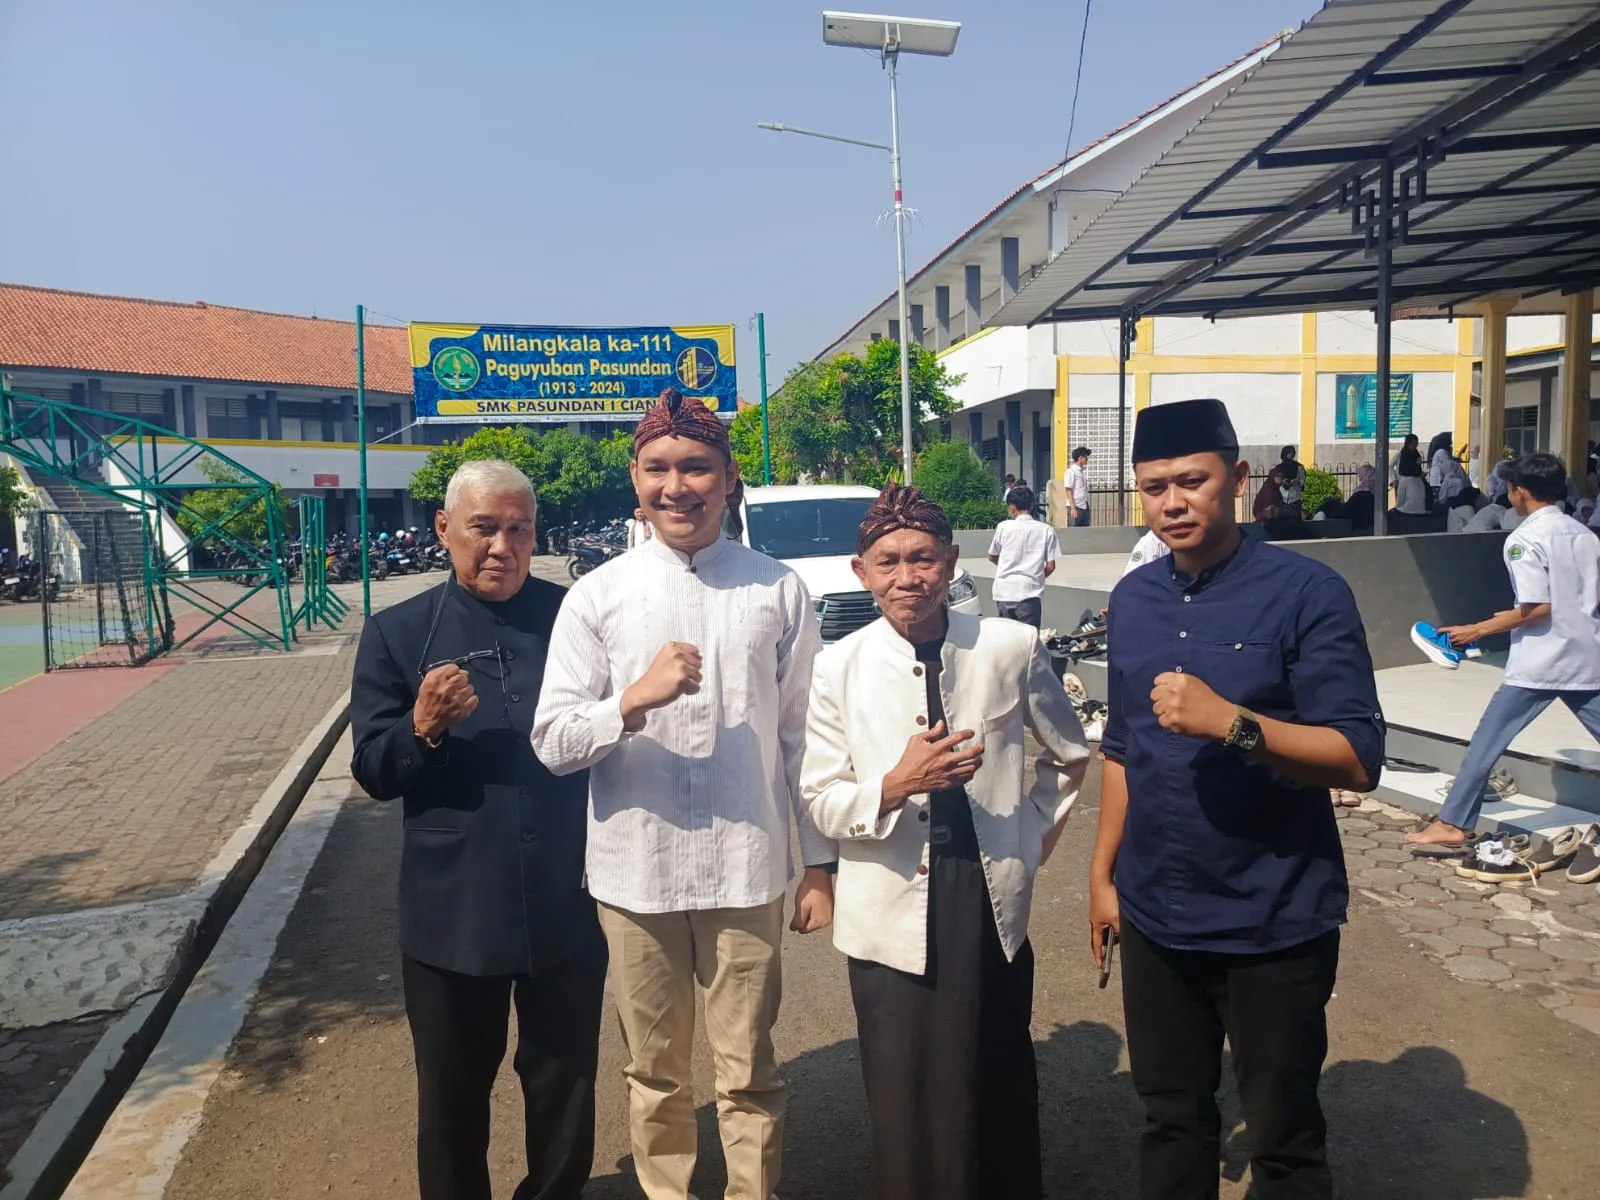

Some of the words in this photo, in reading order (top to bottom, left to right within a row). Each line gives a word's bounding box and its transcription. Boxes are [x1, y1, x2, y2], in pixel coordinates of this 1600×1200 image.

[483, 334, 601, 356] Milangkala
[607, 334, 671, 352] ka-111
[486, 358, 584, 380] Paguyuban
[589, 358, 671, 376] Pasundan
[539, 381, 576, 397] (1913
[590, 381, 626, 397] 2024)
[477, 401, 512, 412] SMK
[517, 400, 605, 412] PASUNDAN
[620, 399, 656, 410] CIAN
